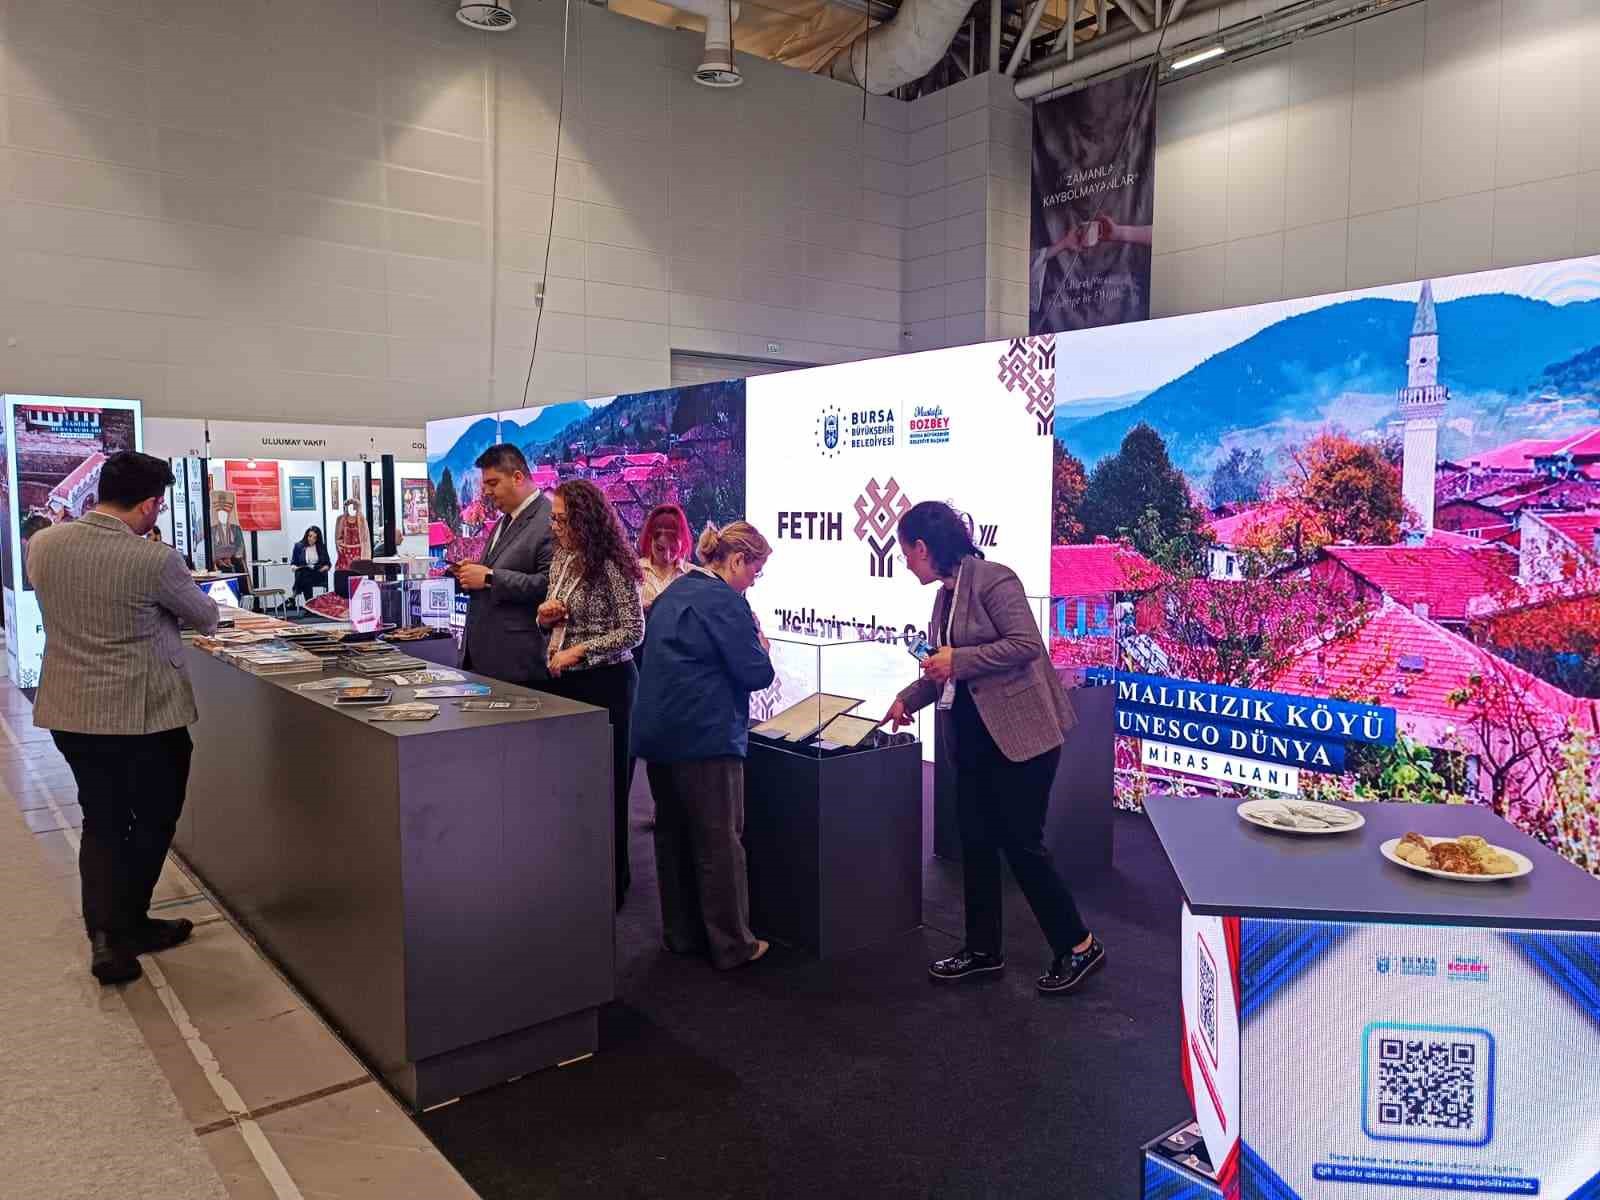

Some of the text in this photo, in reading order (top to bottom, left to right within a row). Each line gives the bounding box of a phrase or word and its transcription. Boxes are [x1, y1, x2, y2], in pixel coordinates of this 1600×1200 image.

[851, 408, 894, 425] BURSA
[910, 417, 949, 430] BOZBEY
[262, 437, 326, 447] ULUUMAY VAKFI
[851, 437, 895, 448] BELEDİYESİ
[777, 511, 843, 541] FETİH
[979, 524, 998, 547] YIL
[1287, 703, 1384, 740] KÖYÜ
[1118, 710, 1331, 768] UNESCO DÜNYA
[1149, 746, 1290, 787] MİRAS ALANI
